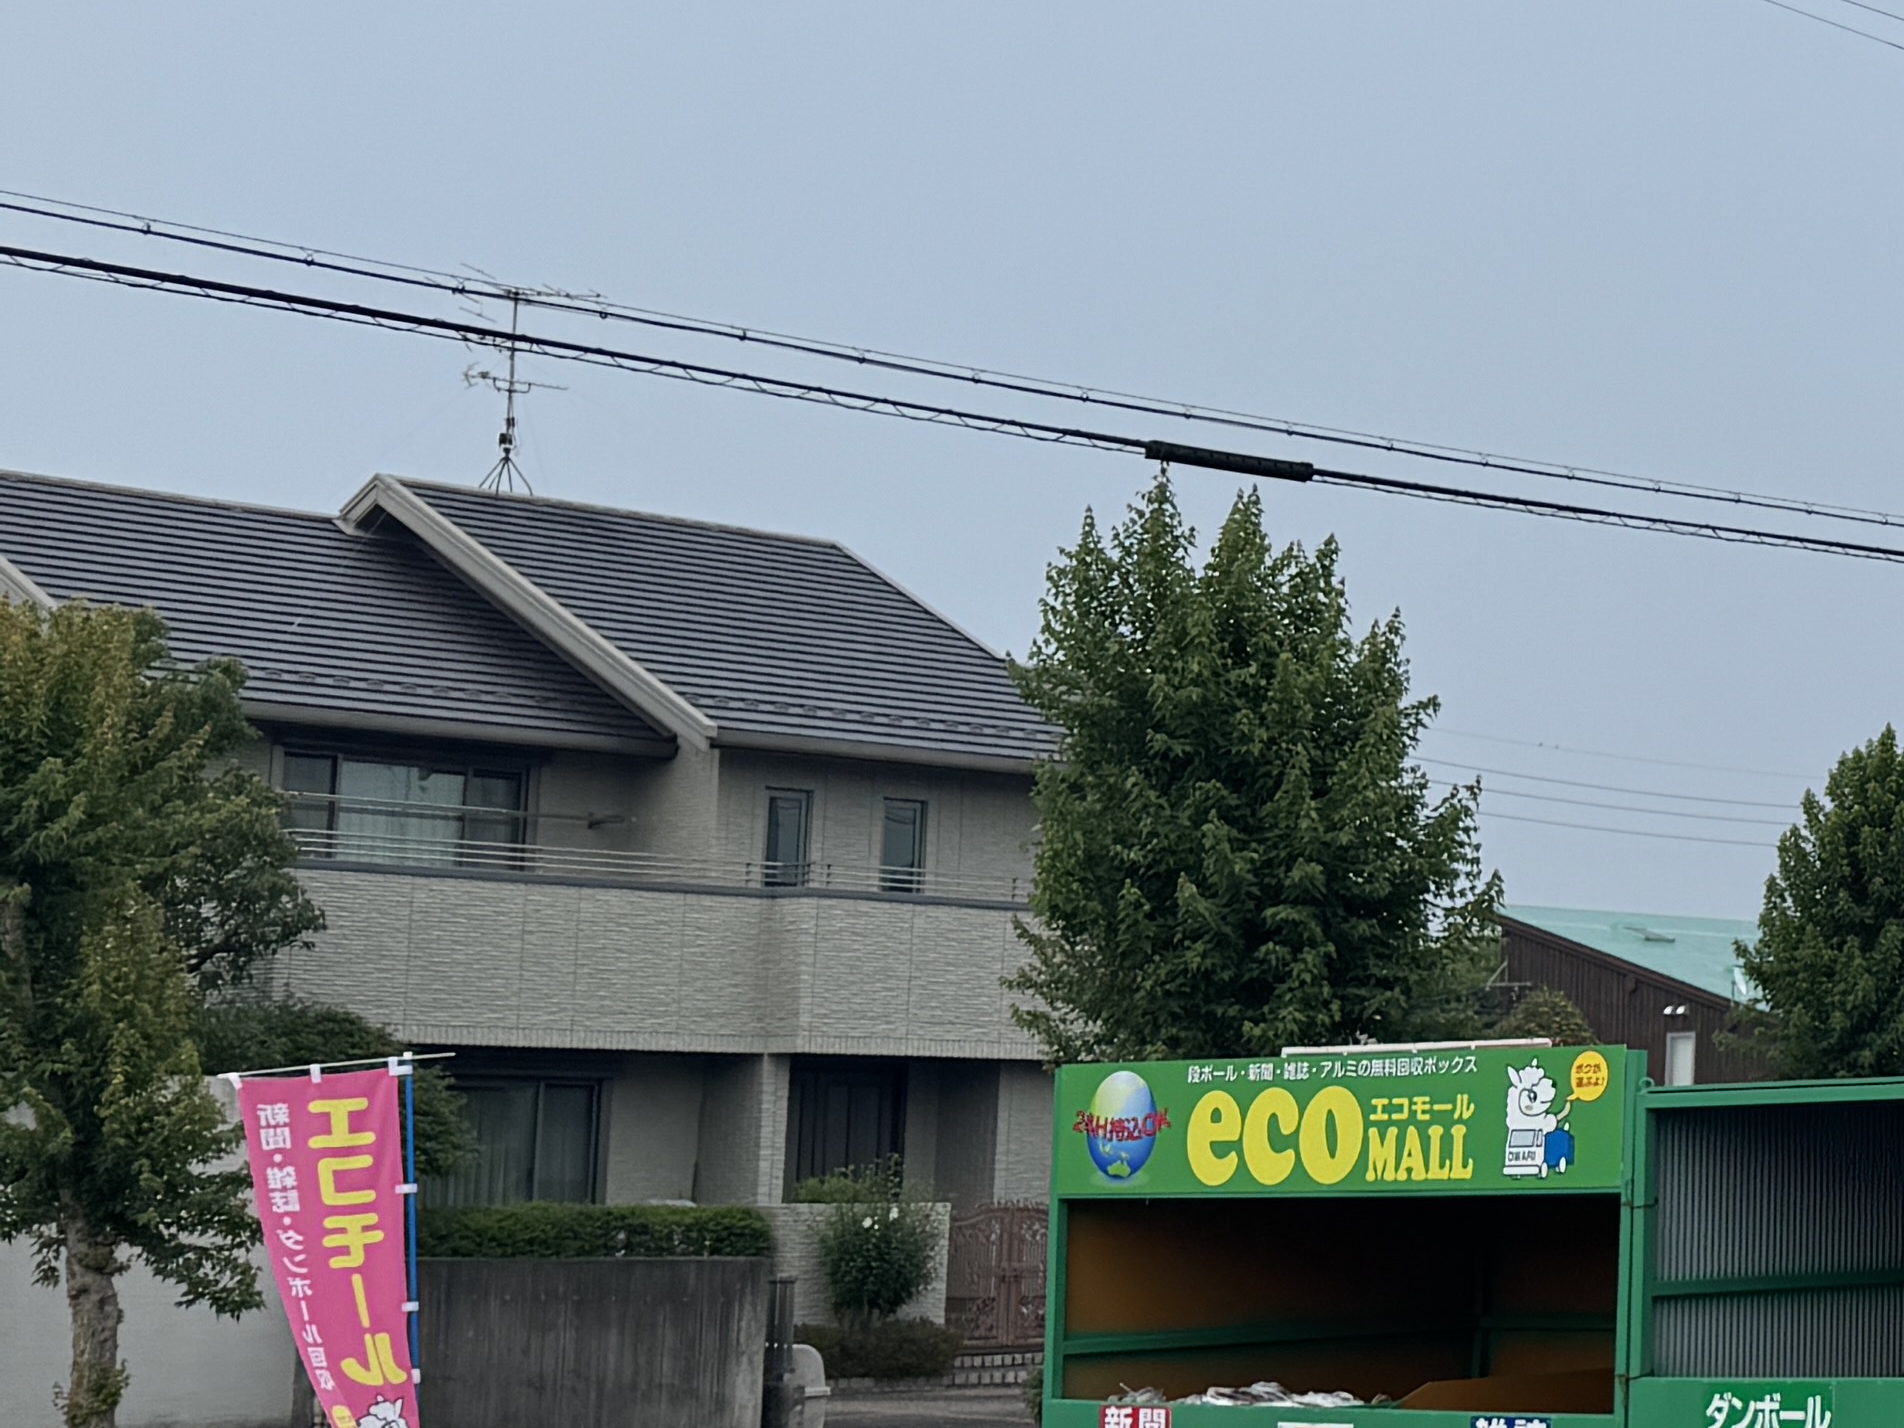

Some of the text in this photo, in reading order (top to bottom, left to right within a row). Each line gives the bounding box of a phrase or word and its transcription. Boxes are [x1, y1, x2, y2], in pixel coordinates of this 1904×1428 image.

[1187, 1056, 1477, 1083] 段ボール・新聞・雑誌・アルミの無料回収ボックス
[1369, 1093, 1475, 1121] エコモール
[1187, 1085, 1364, 1186] eco
[1366, 1124, 1474, 1181] MALL
